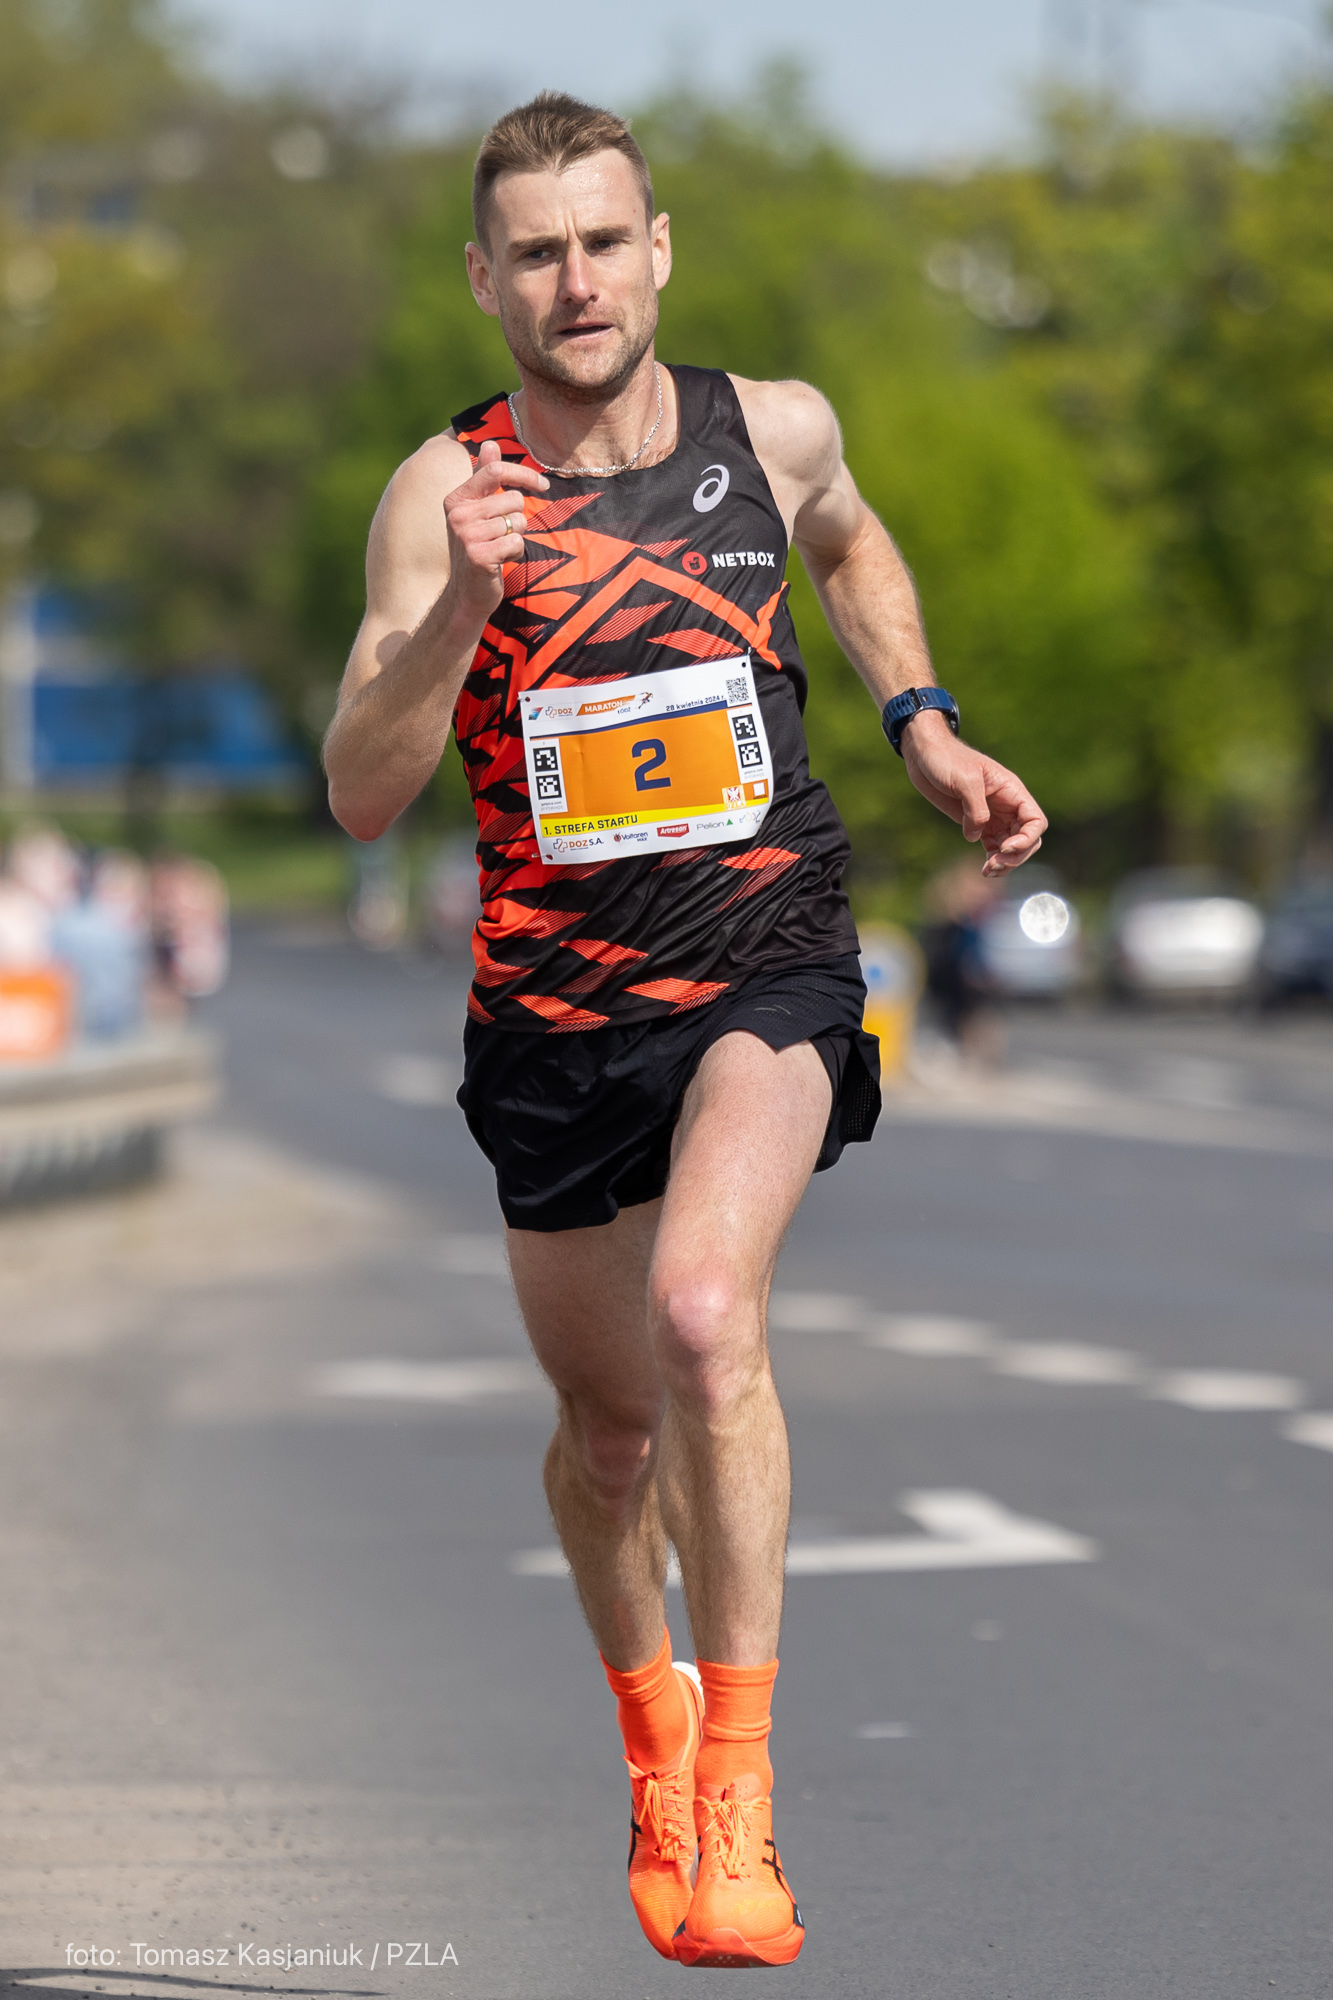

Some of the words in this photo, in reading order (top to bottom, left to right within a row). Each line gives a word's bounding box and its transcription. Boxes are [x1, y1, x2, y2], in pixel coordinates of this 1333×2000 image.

[711, 551, 776, 568] NETBOX
[557, 707, 573, 715] DOZ
[584, 701, 623, 713] MARATON
[666, 704, 675, 712] 28
[676, 700, 704, 709] kwietnia
[705, 695, 720, 703] 2024
[631, 738, 672, 792] 2
[544, 826, 552, 836] 1.
[554, 821, 595, 835] STREFA
[597, 814, 638, 829] STARTU
[696, 821, 725, 831] Pelion
[568, 839, 589, 848] DOZ
[589, 837, 605, 846] S.A.
